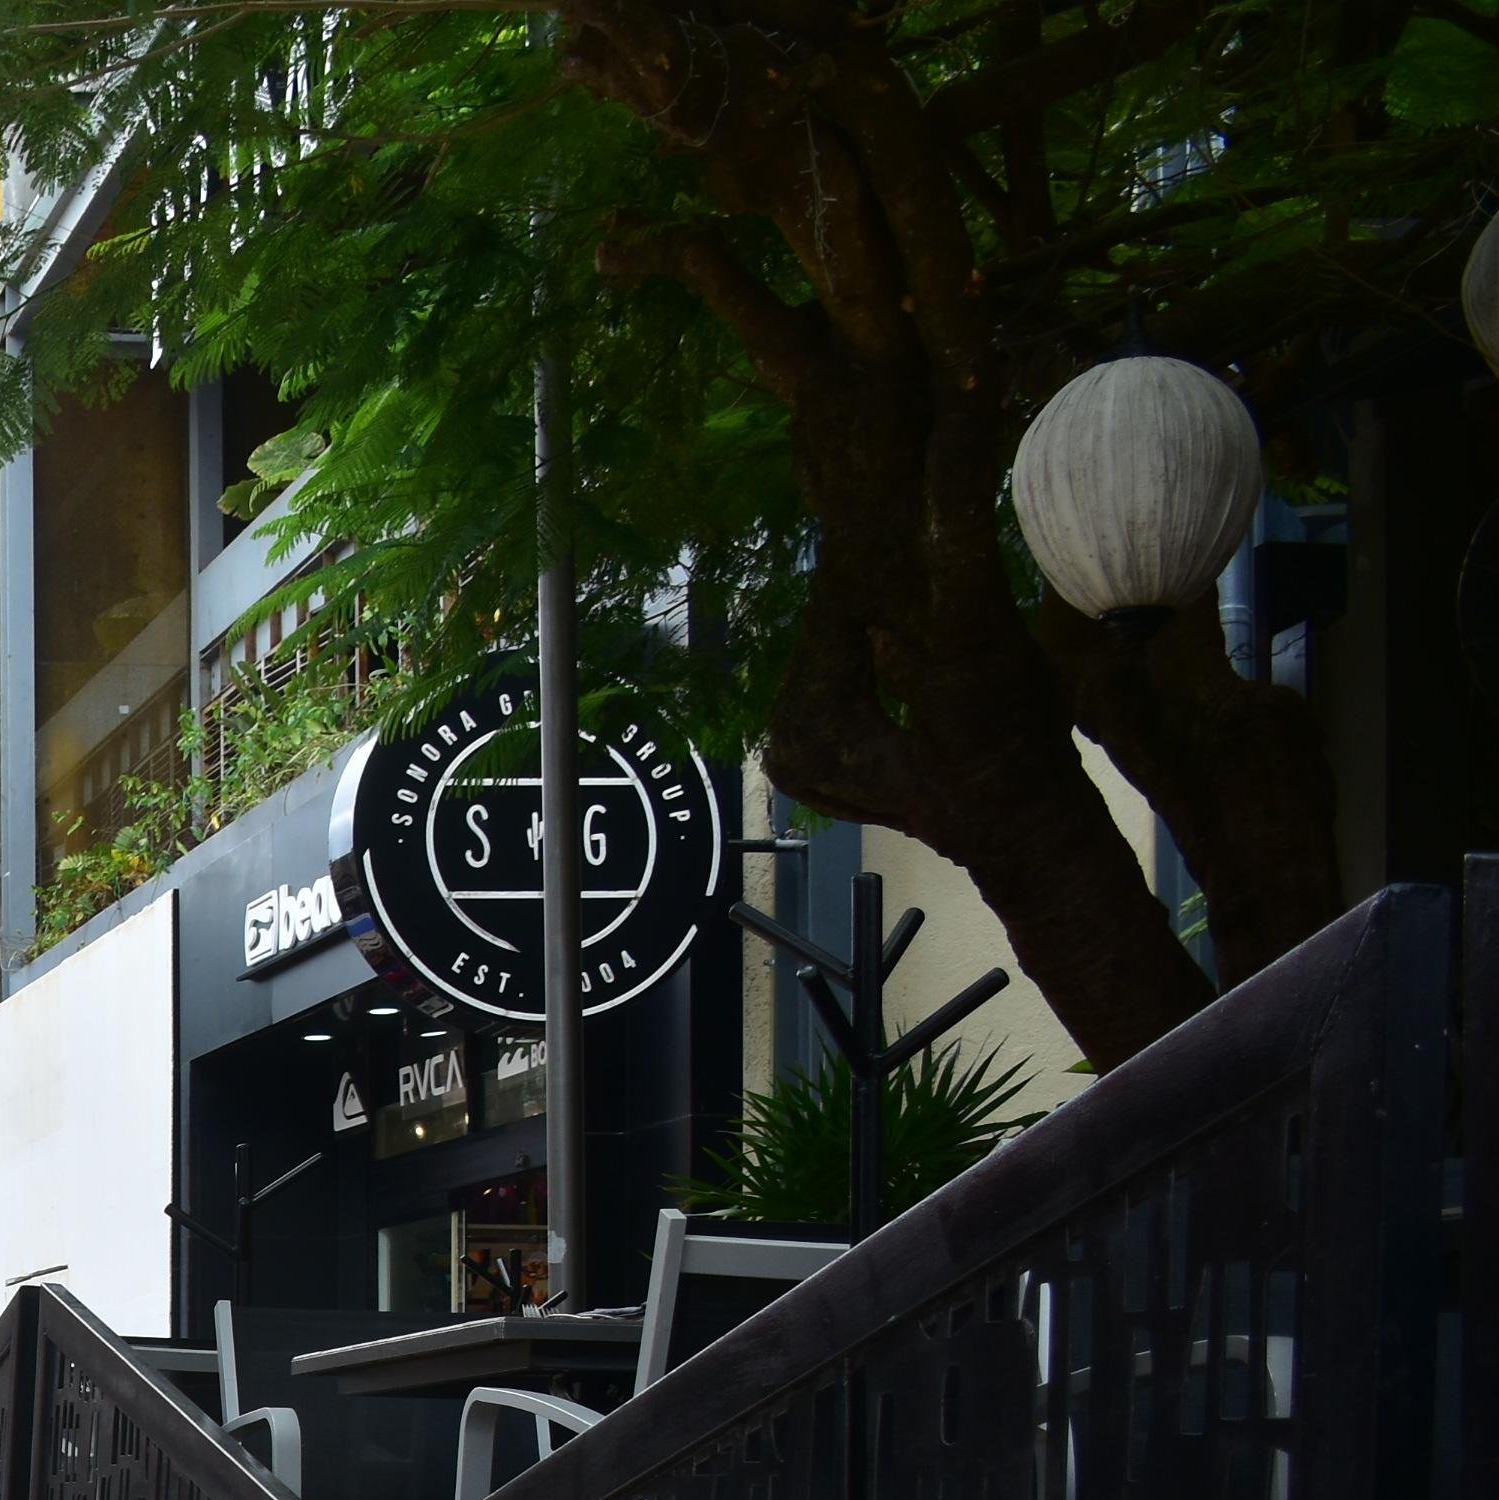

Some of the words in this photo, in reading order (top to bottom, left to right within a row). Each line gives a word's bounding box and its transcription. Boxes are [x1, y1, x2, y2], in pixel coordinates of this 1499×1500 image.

[391, 710, 477, 827] SONORA
[580, 949, 637, 994] 004
[399, 1047, 464, 1107] RVCA
